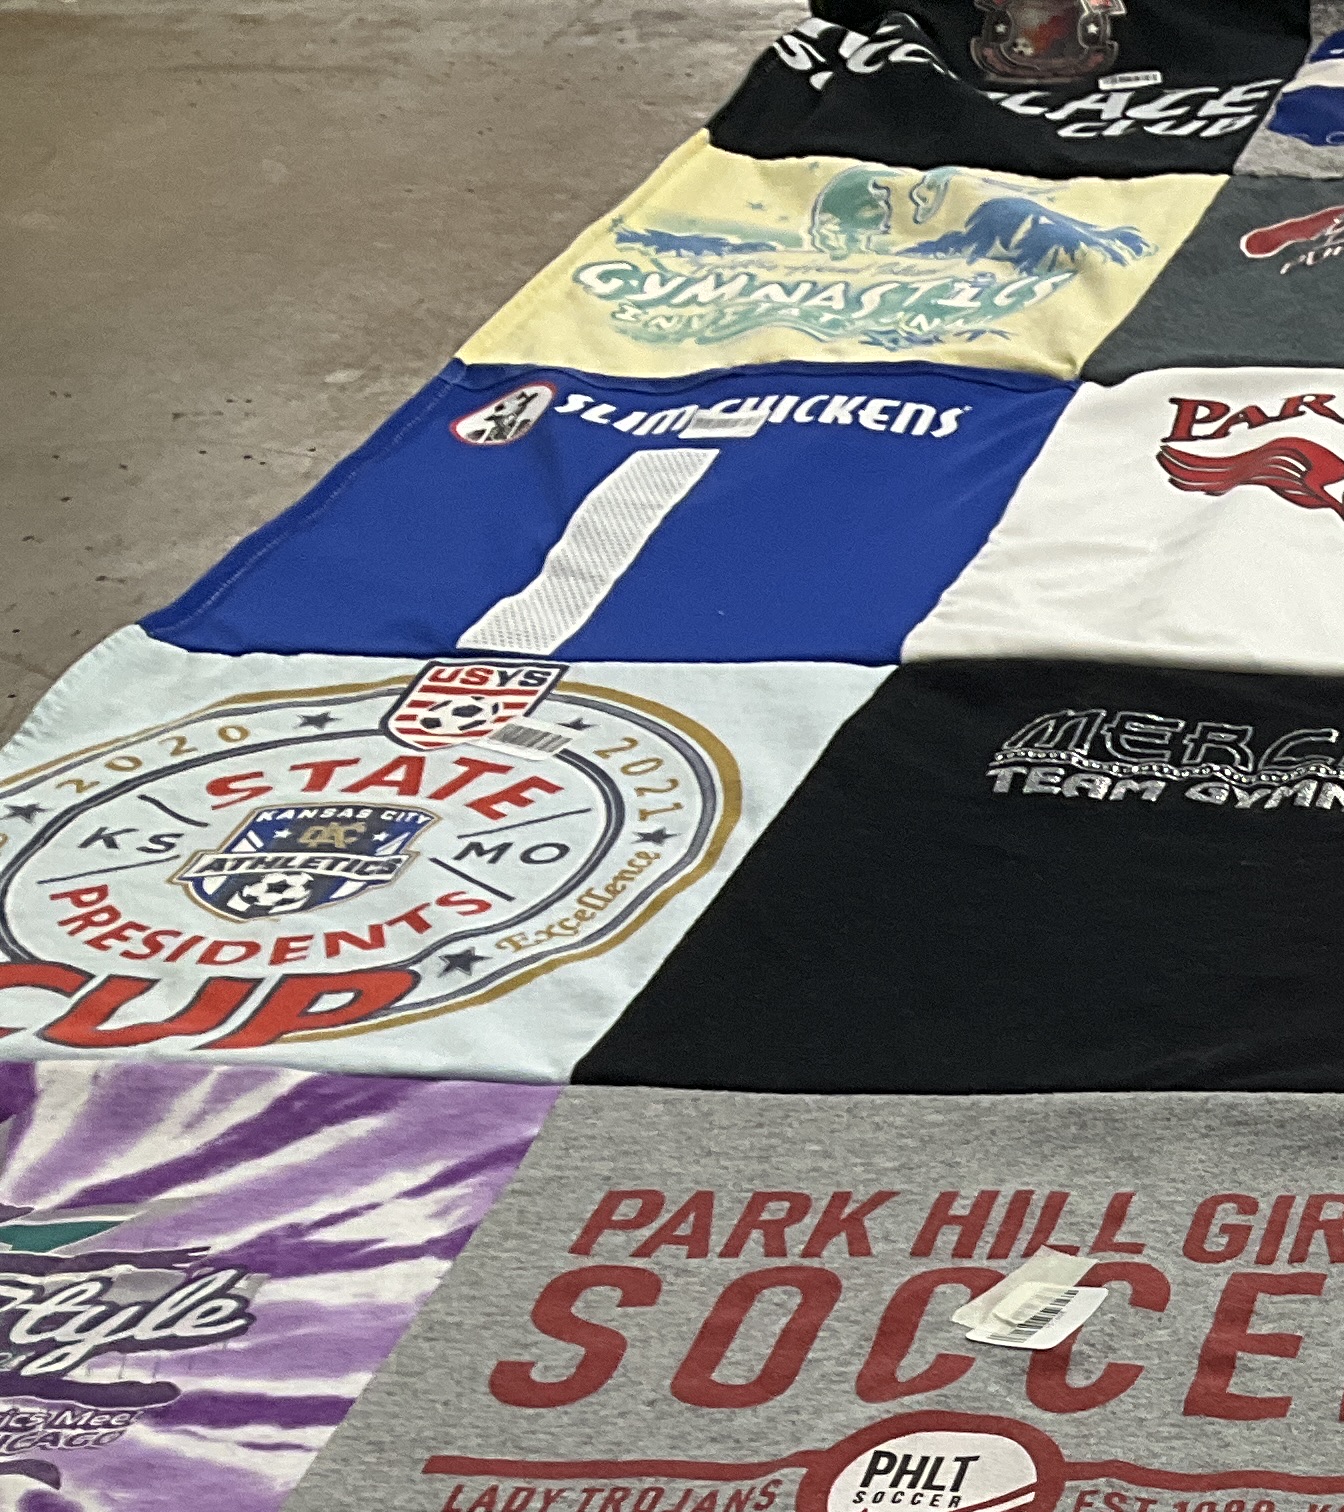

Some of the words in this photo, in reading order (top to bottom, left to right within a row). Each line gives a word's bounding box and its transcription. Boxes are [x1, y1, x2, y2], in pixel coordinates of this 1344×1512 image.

[986, 79, 1283, 119] LAZE
[1056, 115, 1258, 138] CLUB
[572, 260, 1075, 318] GYMNASTICS
[705, 394, 964, 438] CHICKENS
[426, 665, 552, 688] USYS
[205, 755, 565, 821] STATE
[593, 737, 684, 822] 2021
[987, 767, 1167, 802] TEAM
[256, 807, 374, 823] KANSAS
[379, 809, 434, 825] CITY
[79, 824, 187, 854] KS
[454, 839, 572, 867] MO
[194, 854, 402, 877] ATHLETICS
[496, 849, 661, 953] Excellence
[51, 883, 494, 966] PRESIDENTS
[569, 1190, 876, 1259] PARK
[909, 1191, 1152, 1260] HILL
[0, 1269, 251, 1376] tyle
[860, 1449, 981, 1494] PHLT
[850, 1490, 965, 1511] SOCCER
